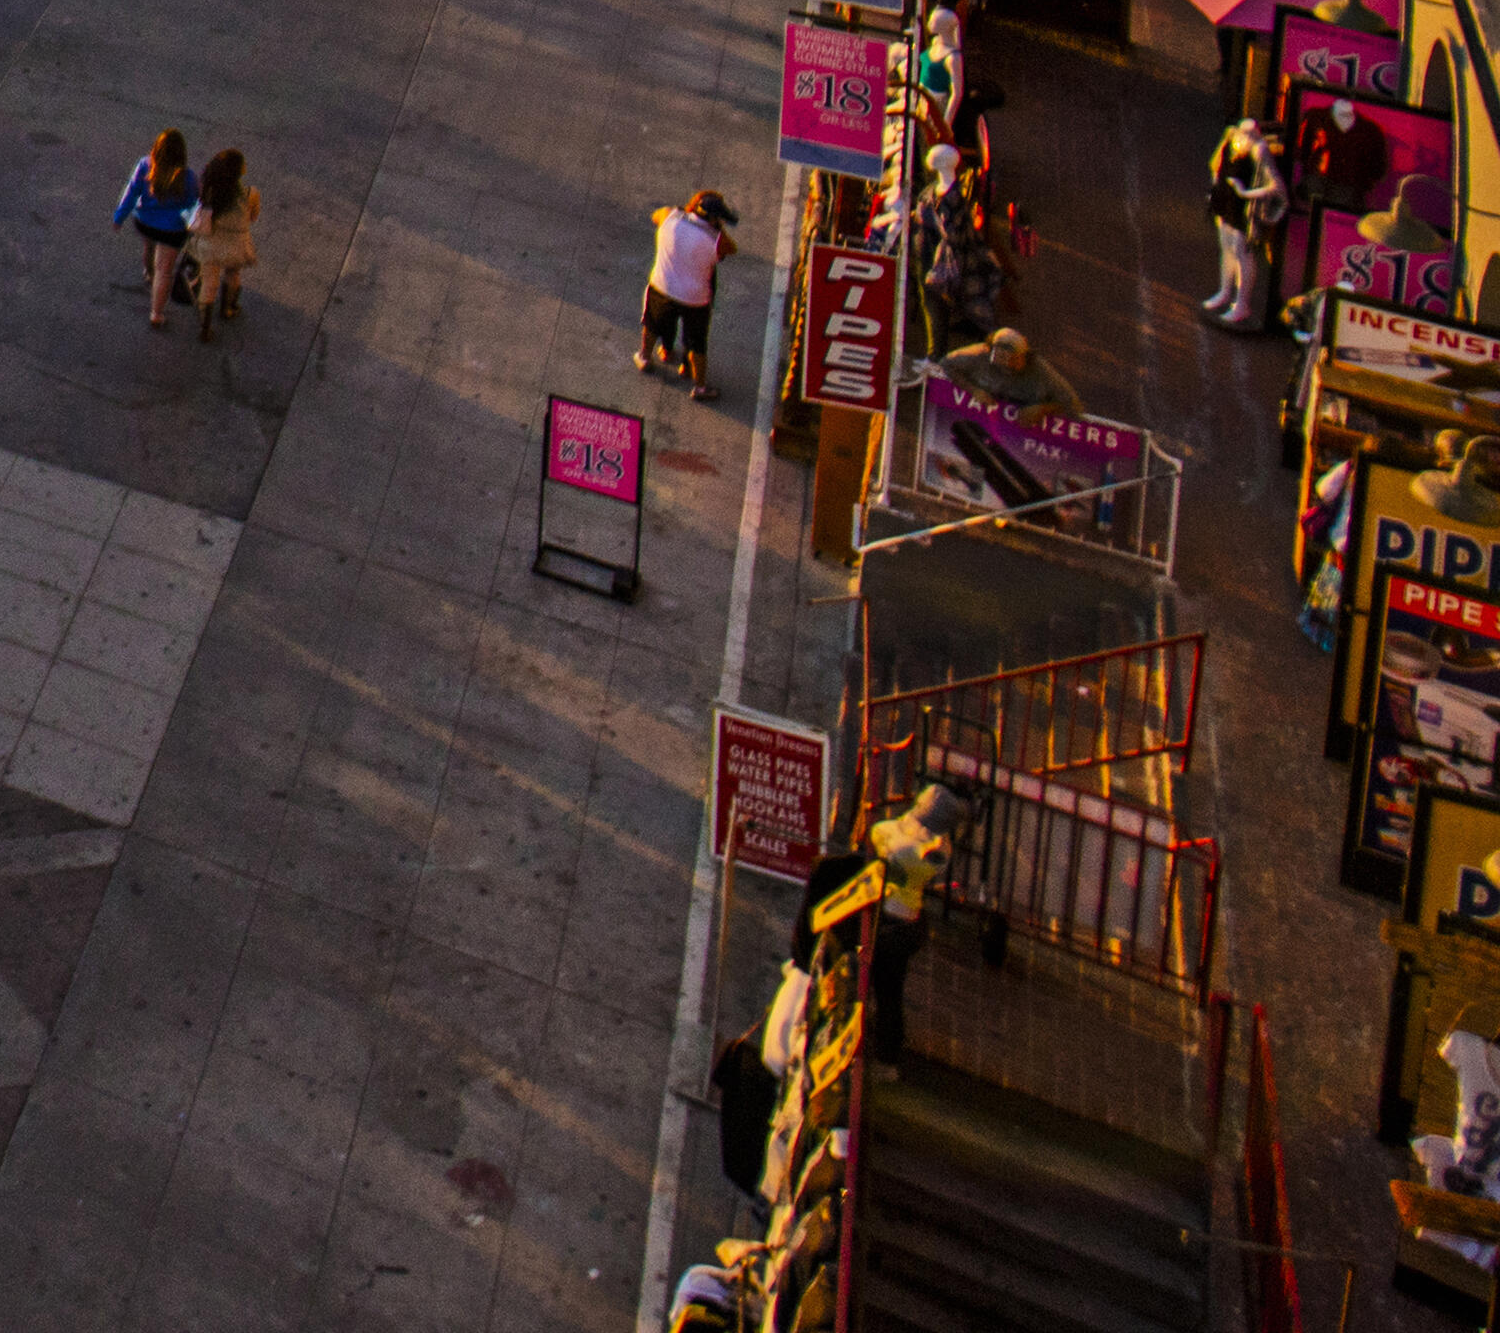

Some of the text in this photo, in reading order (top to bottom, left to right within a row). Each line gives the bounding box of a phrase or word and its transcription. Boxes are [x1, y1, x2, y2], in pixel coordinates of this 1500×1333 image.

[795, 29, 867, 51] HUNDREDS OF
[795, 40, 867, 63] WOMEN'S
[794, 52, 882, 78] CLOTHING STYLES
[795, 69, 872, 117] $18
[819, 255, 885, 401] PIPES
[558, 438, 624, 481] $18
[1403, 582, 1484, 626] PIPE
[725, 719, 820, 758] Venetian Dreams
[728, 760, 813, 797] WATER PIPES
[729, 743, 811, 779] GLASS PIPES
[738, 779, 801, 809] BUBBLERS
[744, 830, 789, 856] SCALES
